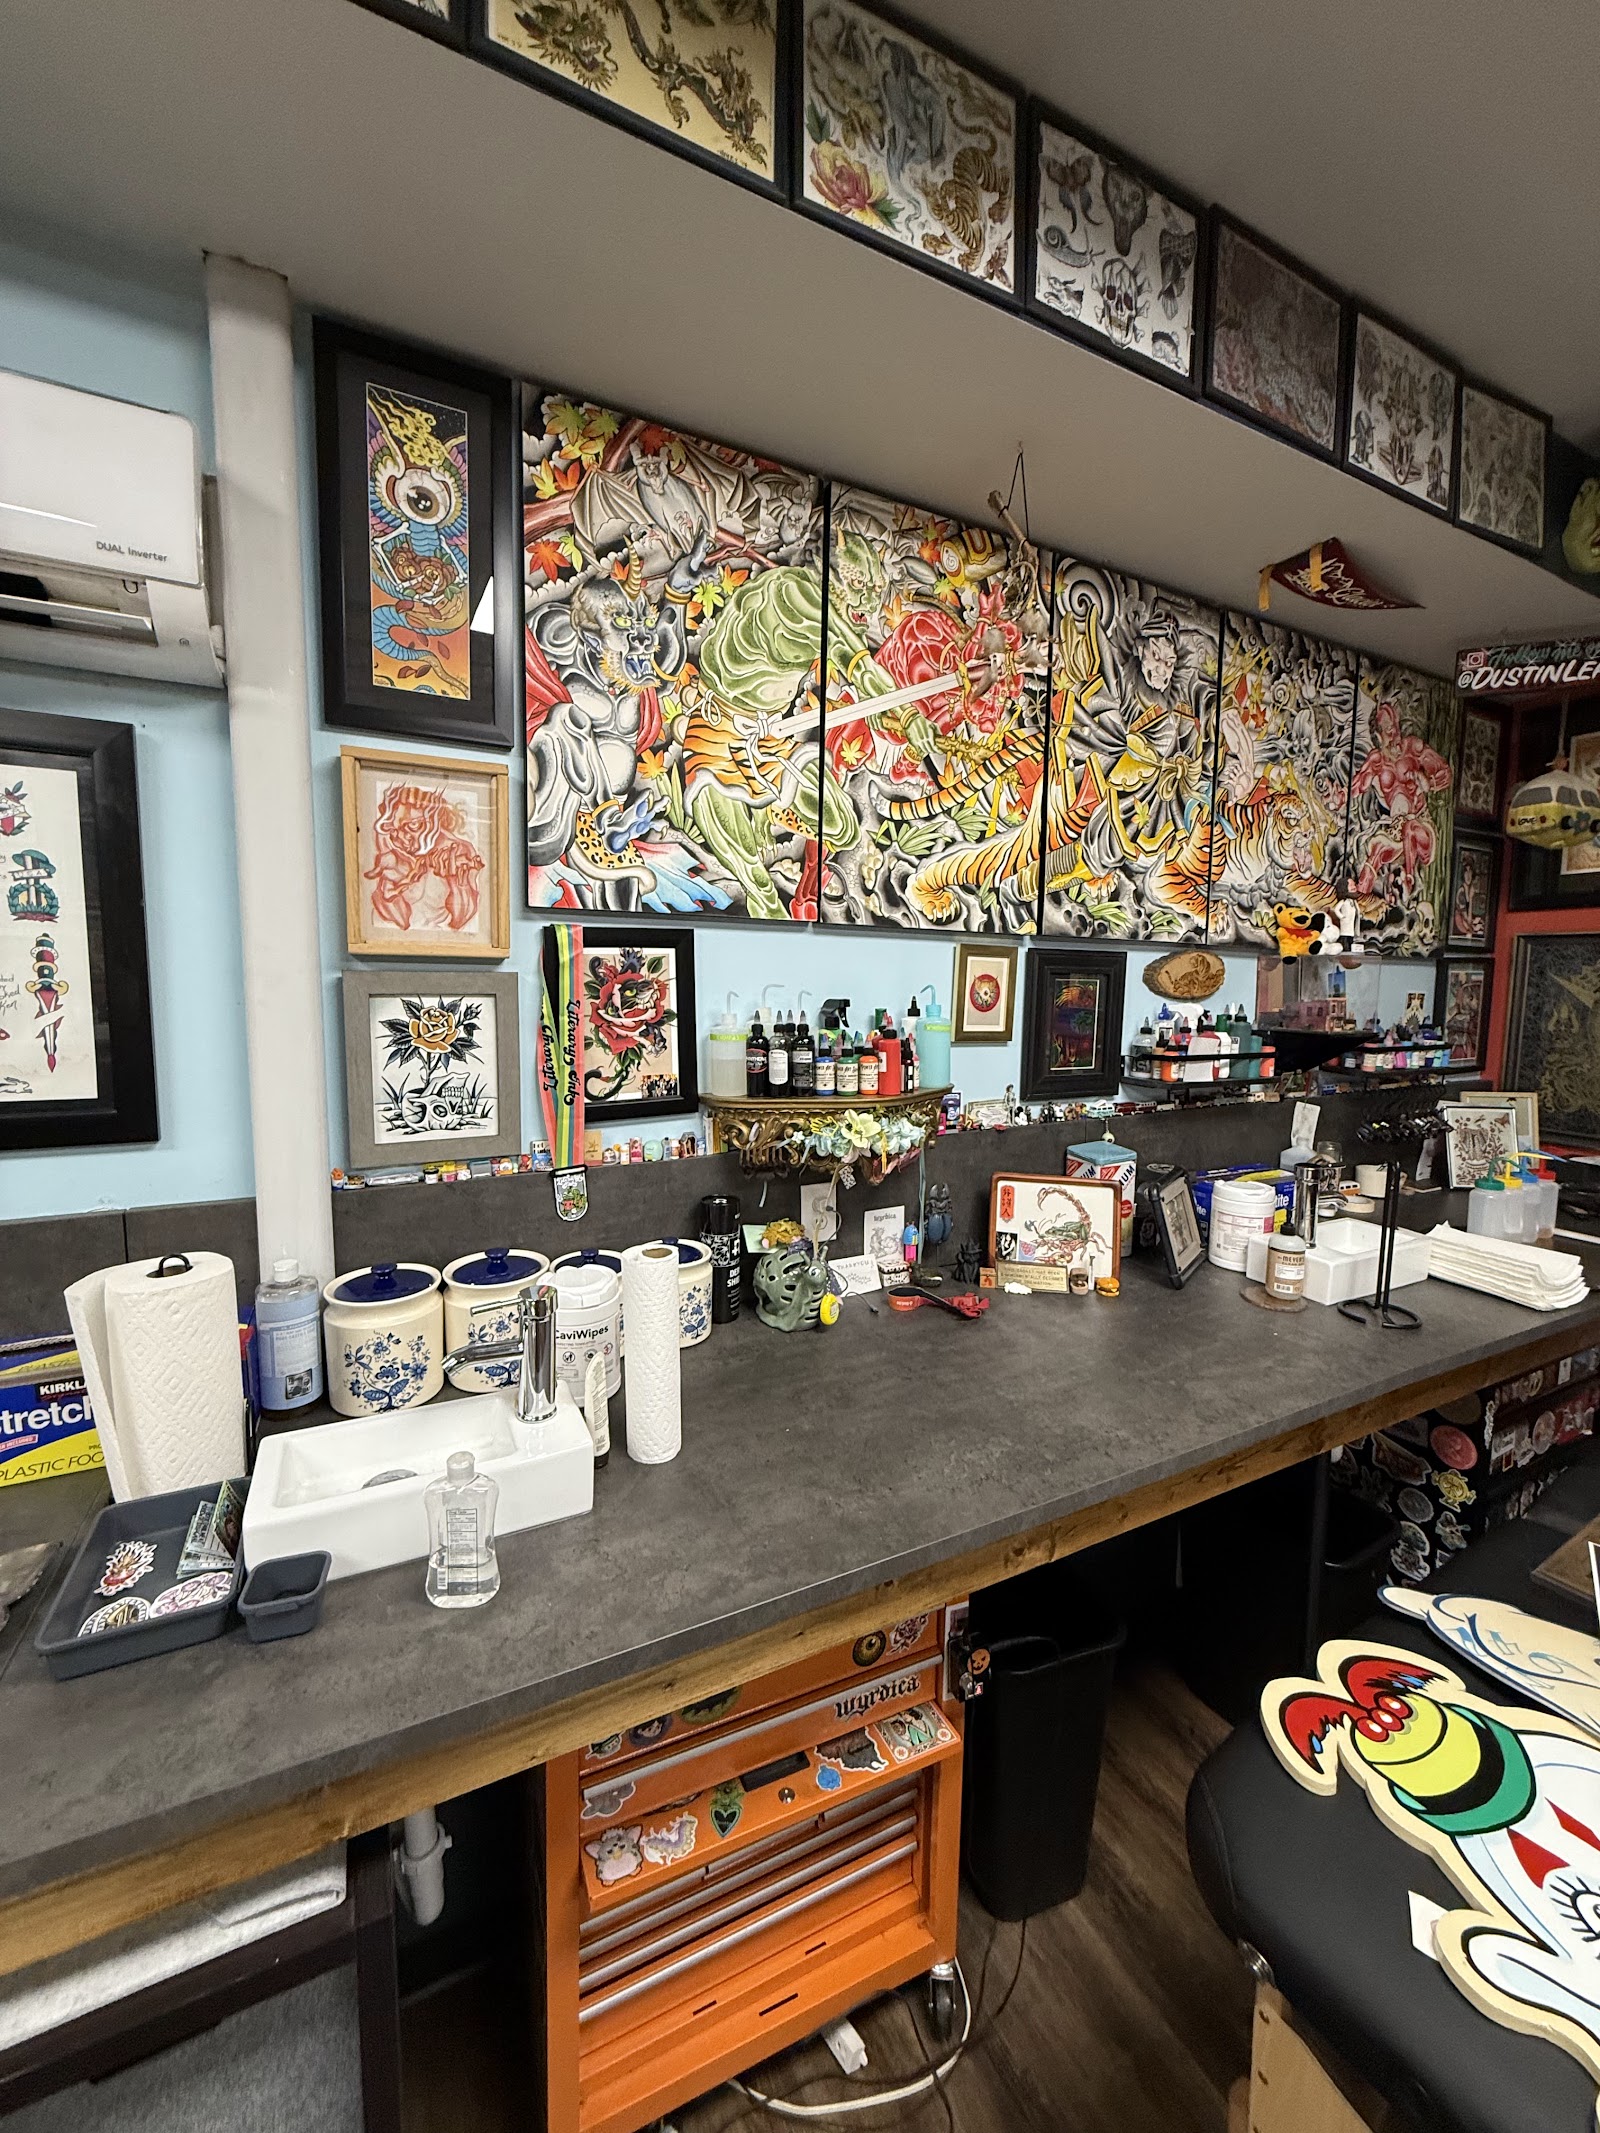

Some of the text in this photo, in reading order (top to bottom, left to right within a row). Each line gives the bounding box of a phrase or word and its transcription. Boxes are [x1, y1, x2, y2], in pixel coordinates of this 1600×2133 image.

[96, 541, 168, 562] DUAL Inverter
[563, 999, 581, 1106] Literary Ink
[0, 1396, 95, 1435] tretc
[0, 1452, 105, 1480] PLASTIC FOO
[836, 1675, 921, 1723] wyrdica
